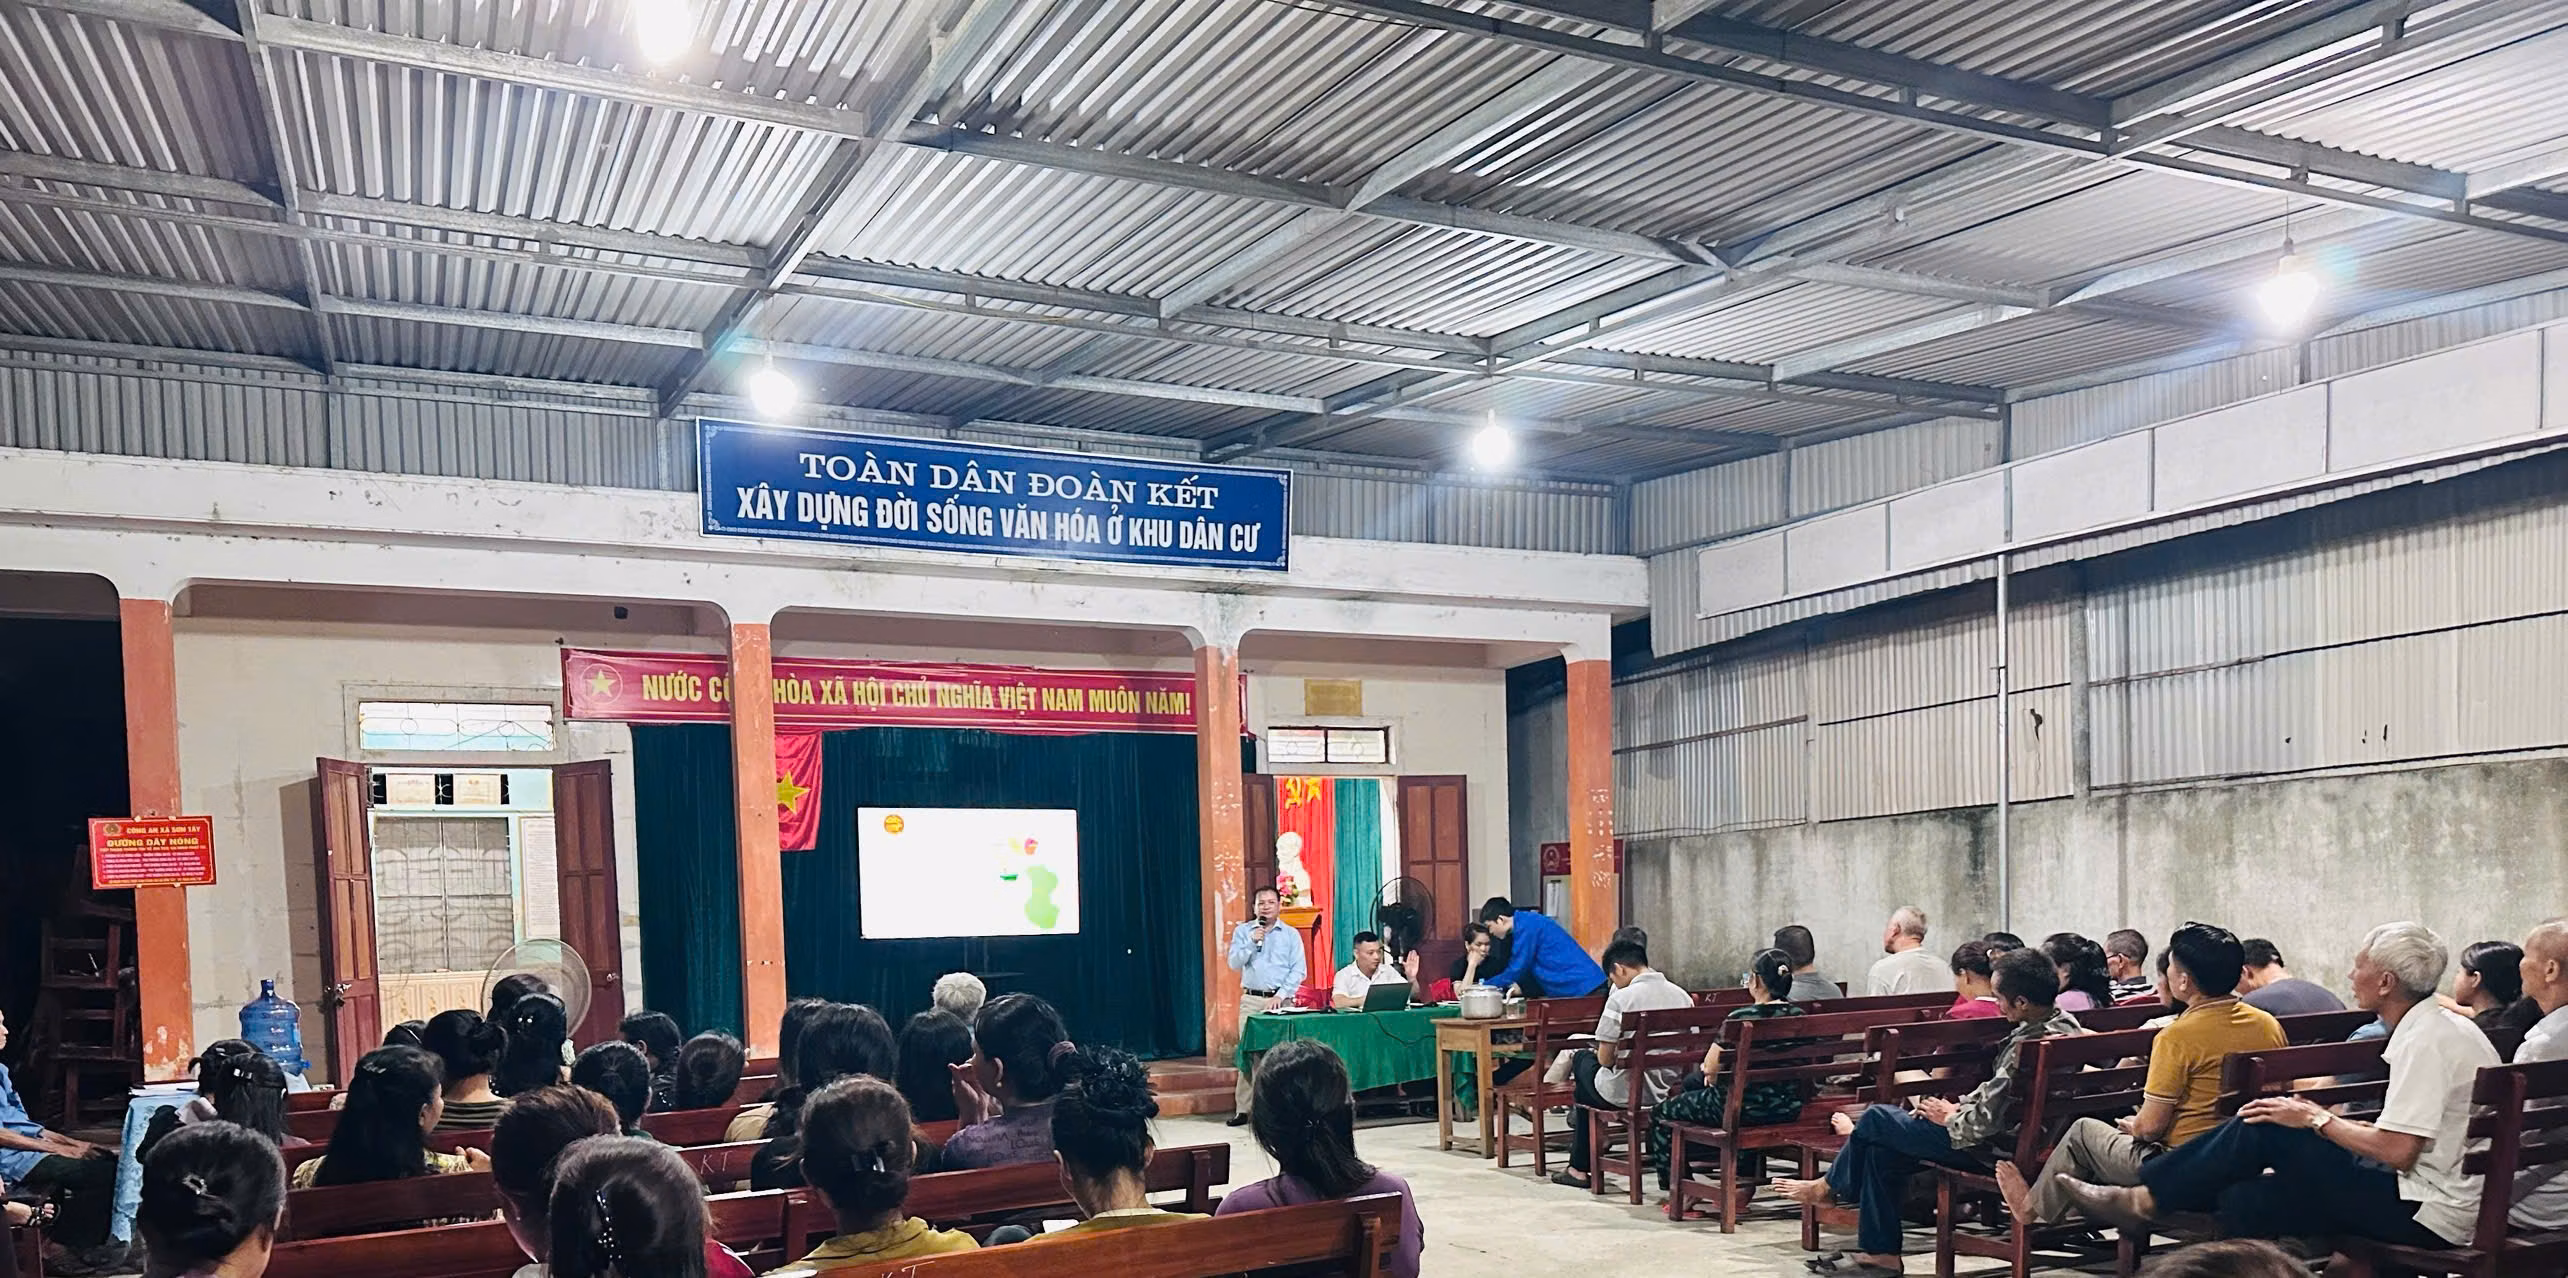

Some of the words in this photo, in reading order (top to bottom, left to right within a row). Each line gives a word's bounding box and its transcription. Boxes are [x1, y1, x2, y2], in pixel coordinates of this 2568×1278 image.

[800, 450, 917, 486] TOÀN
[929, 459, 1017, 494] DÂN
[1028, 470, 1137, 504] ĐOÀN
[1147, 474, 1219, 509] KẾT
[736, 481, 789, 521] XÂY
[797, 490, 869, 531] DỰNG
[875, 491, 918, 531] ĐỜI
[926, 493, 993, 537] SỐNG
[1000, 502, 1047, 540] VĂN
[1054, 506, 1101, 544] HÓA
[1106, 503, 1124, 546] Ở
[1128, 517, 1173, 548] KHU
[1179, 515, 1224, 551] DÂN
[1229, 521, 1262, 552] CƯ
[642, 669, 703, 702] NƯỚC
[772, 672, 815, 704] HÒA
[819, 675, 848, 705] XÃ
[852, 676, 887, 712] HỘI
[891, 675, 931, 708] CHỦ
[936, 680, 994, 710] NGHĨA
[999, 681, 1037, 715] VIỆT
[1041, 686, 1084, 712] NAM
[1088, 685, 1141, 714] MUÔN
[1145, 686, 1191, 715] NĂM!
[701, 1150, 733, 1175] KT
